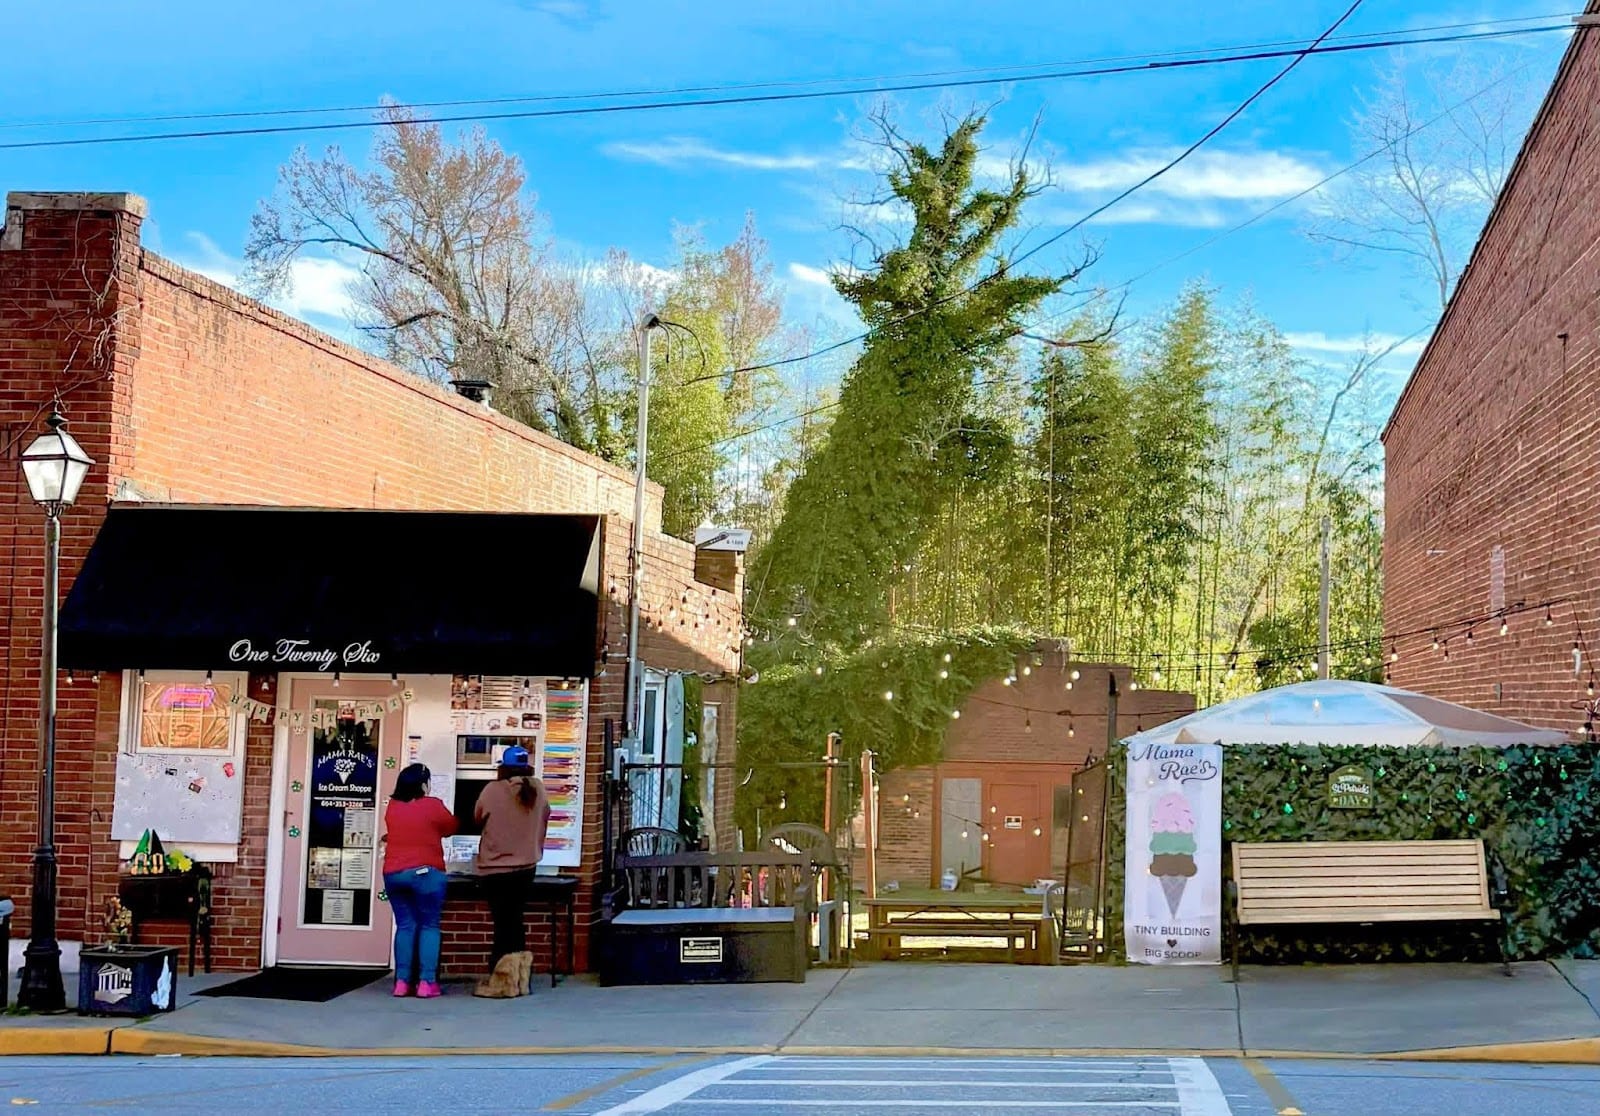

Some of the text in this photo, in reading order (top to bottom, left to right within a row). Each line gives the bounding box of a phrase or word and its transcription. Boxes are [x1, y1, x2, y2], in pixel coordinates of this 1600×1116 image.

[229, 639, 380, 671] One Twenty Six
[317, 749, 373, 768] MAMA RAE'S
[1132, 744, 1194, 761] Mama
[1158, 759, 1217, 784] Rae's
[318, 783, 372, 793] Ice Cream Shoppe
[1134, 925, 1211, 937] TINY BUILDING
[1144, 948, 1202, 959] BIG SCOOP
